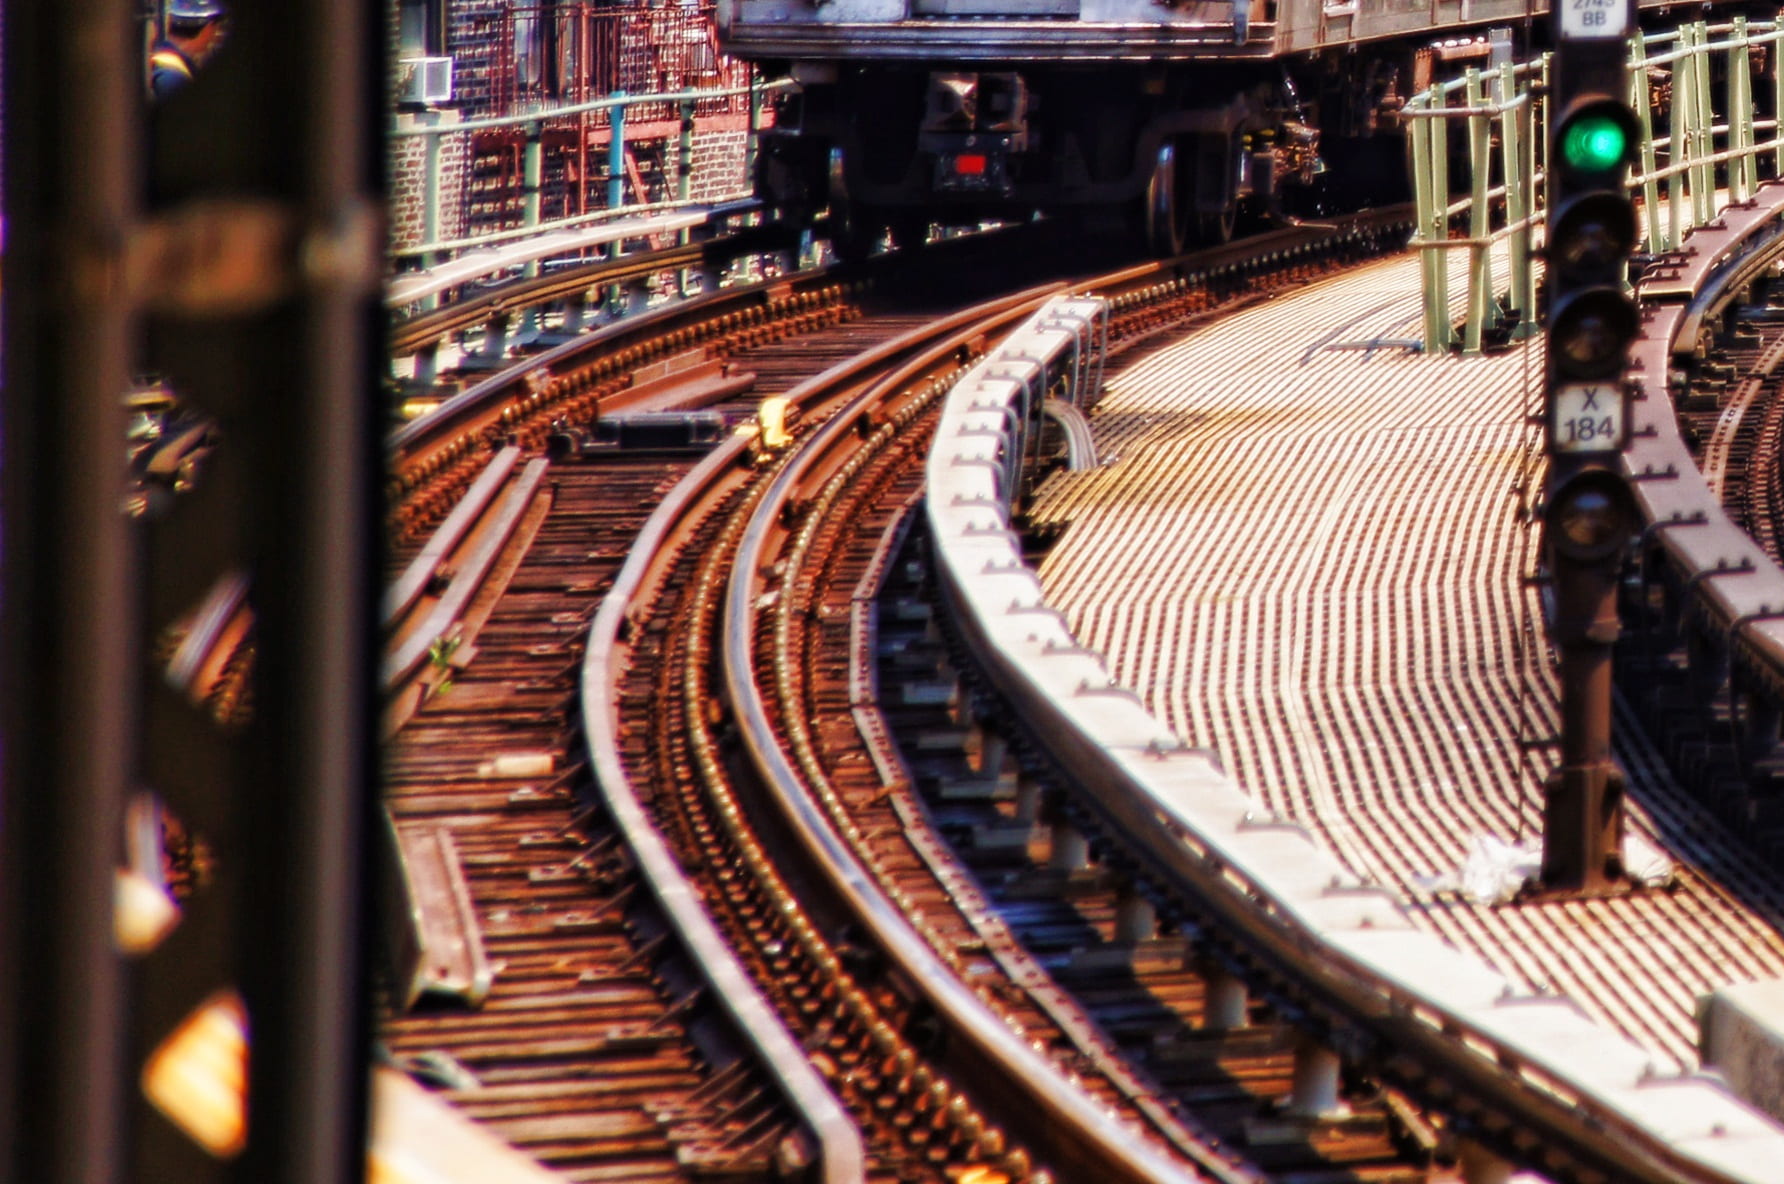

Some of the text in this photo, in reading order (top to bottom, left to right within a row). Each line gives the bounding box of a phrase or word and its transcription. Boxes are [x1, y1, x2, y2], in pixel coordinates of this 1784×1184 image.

[1582, 11, 1607, 26] BB
[1582, 388, 1599, 411] X
[1564, 417, 1614, 441] 184
